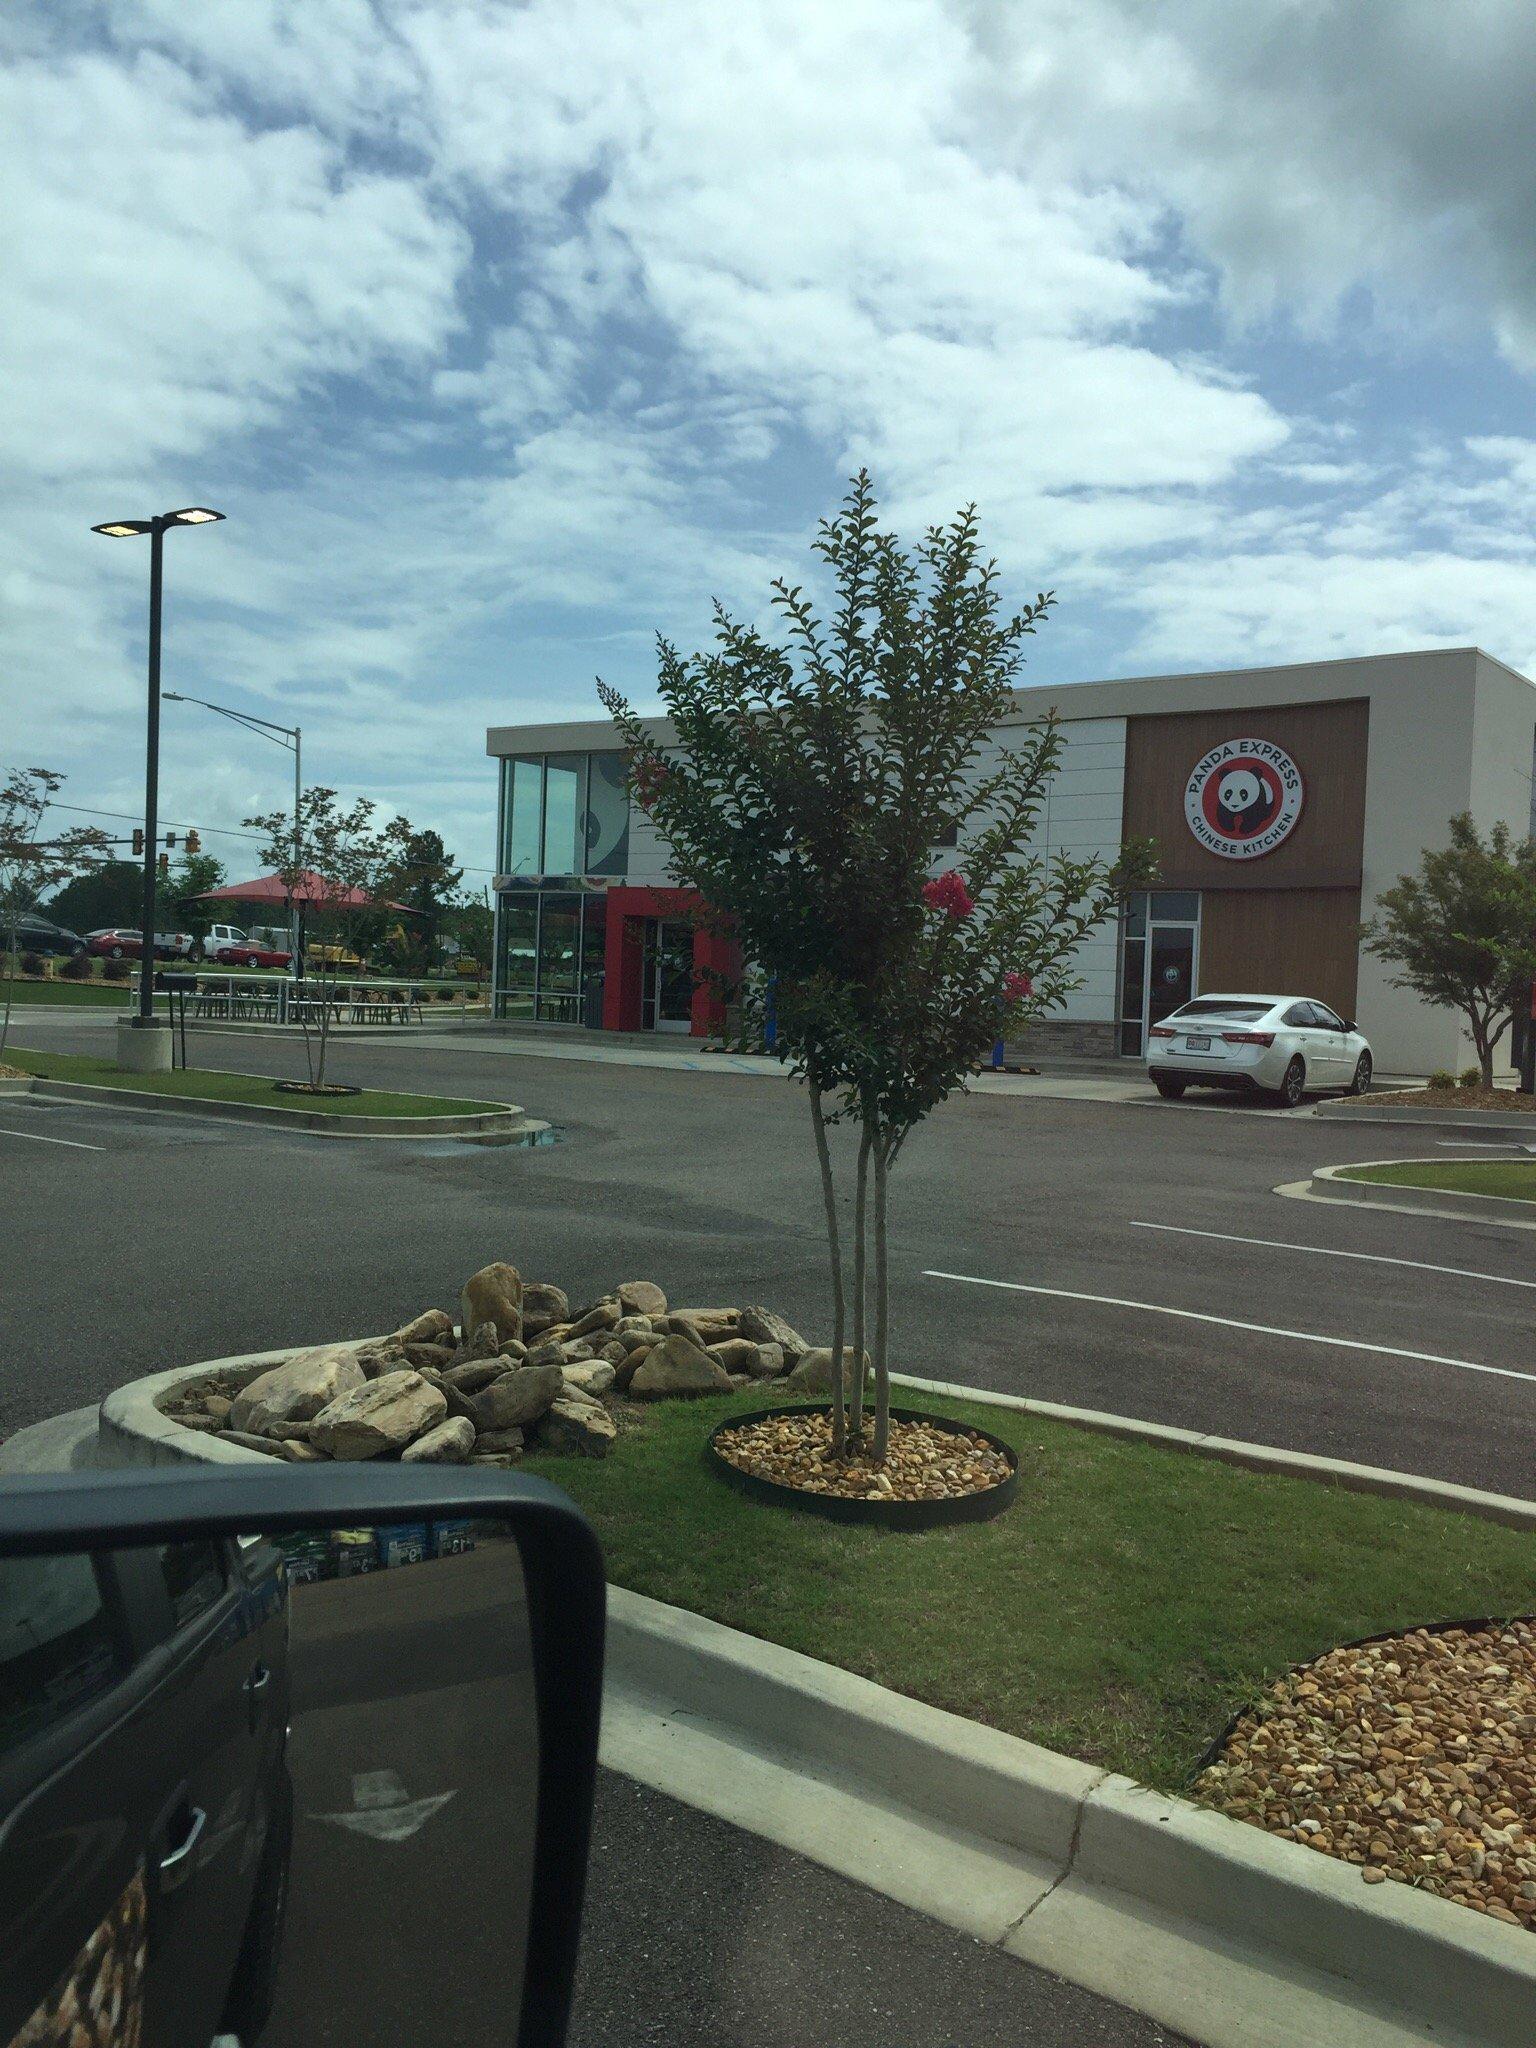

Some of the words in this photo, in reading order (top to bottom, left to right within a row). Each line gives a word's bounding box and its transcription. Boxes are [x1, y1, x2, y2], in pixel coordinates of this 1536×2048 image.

[1189, 746, 1234, 793] PANDA
[1239, 741, 1298, 790] EXPRESS
[1192, 816, 1237, 854] CHINESE
[1243, 813, 1293, 854] KITCHEN
